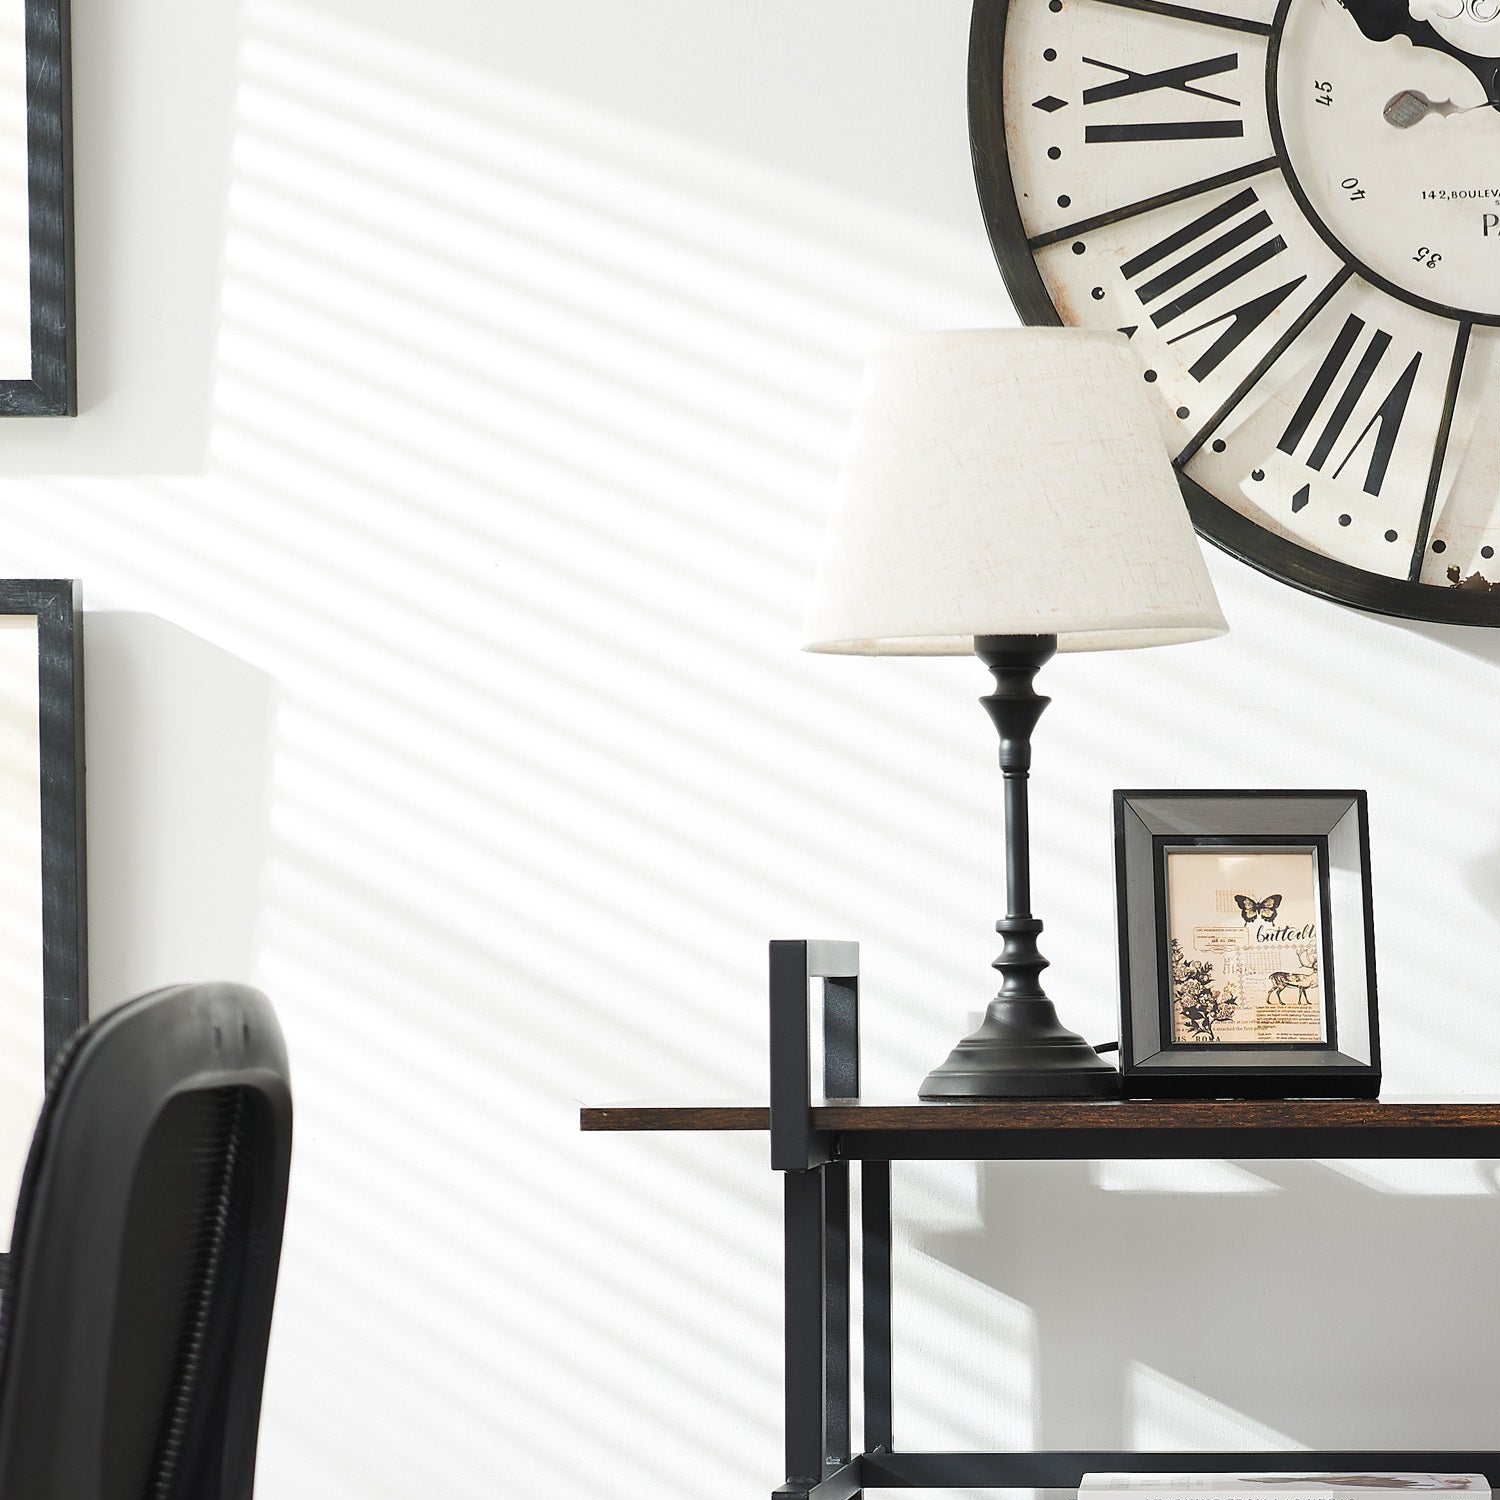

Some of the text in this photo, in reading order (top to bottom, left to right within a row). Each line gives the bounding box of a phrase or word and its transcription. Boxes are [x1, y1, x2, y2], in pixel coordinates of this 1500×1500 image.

[1315, 81, 1332, 106] 45
[1342, 178, 1365, 201] 40
[1412, 247, 1442, 268] 35
